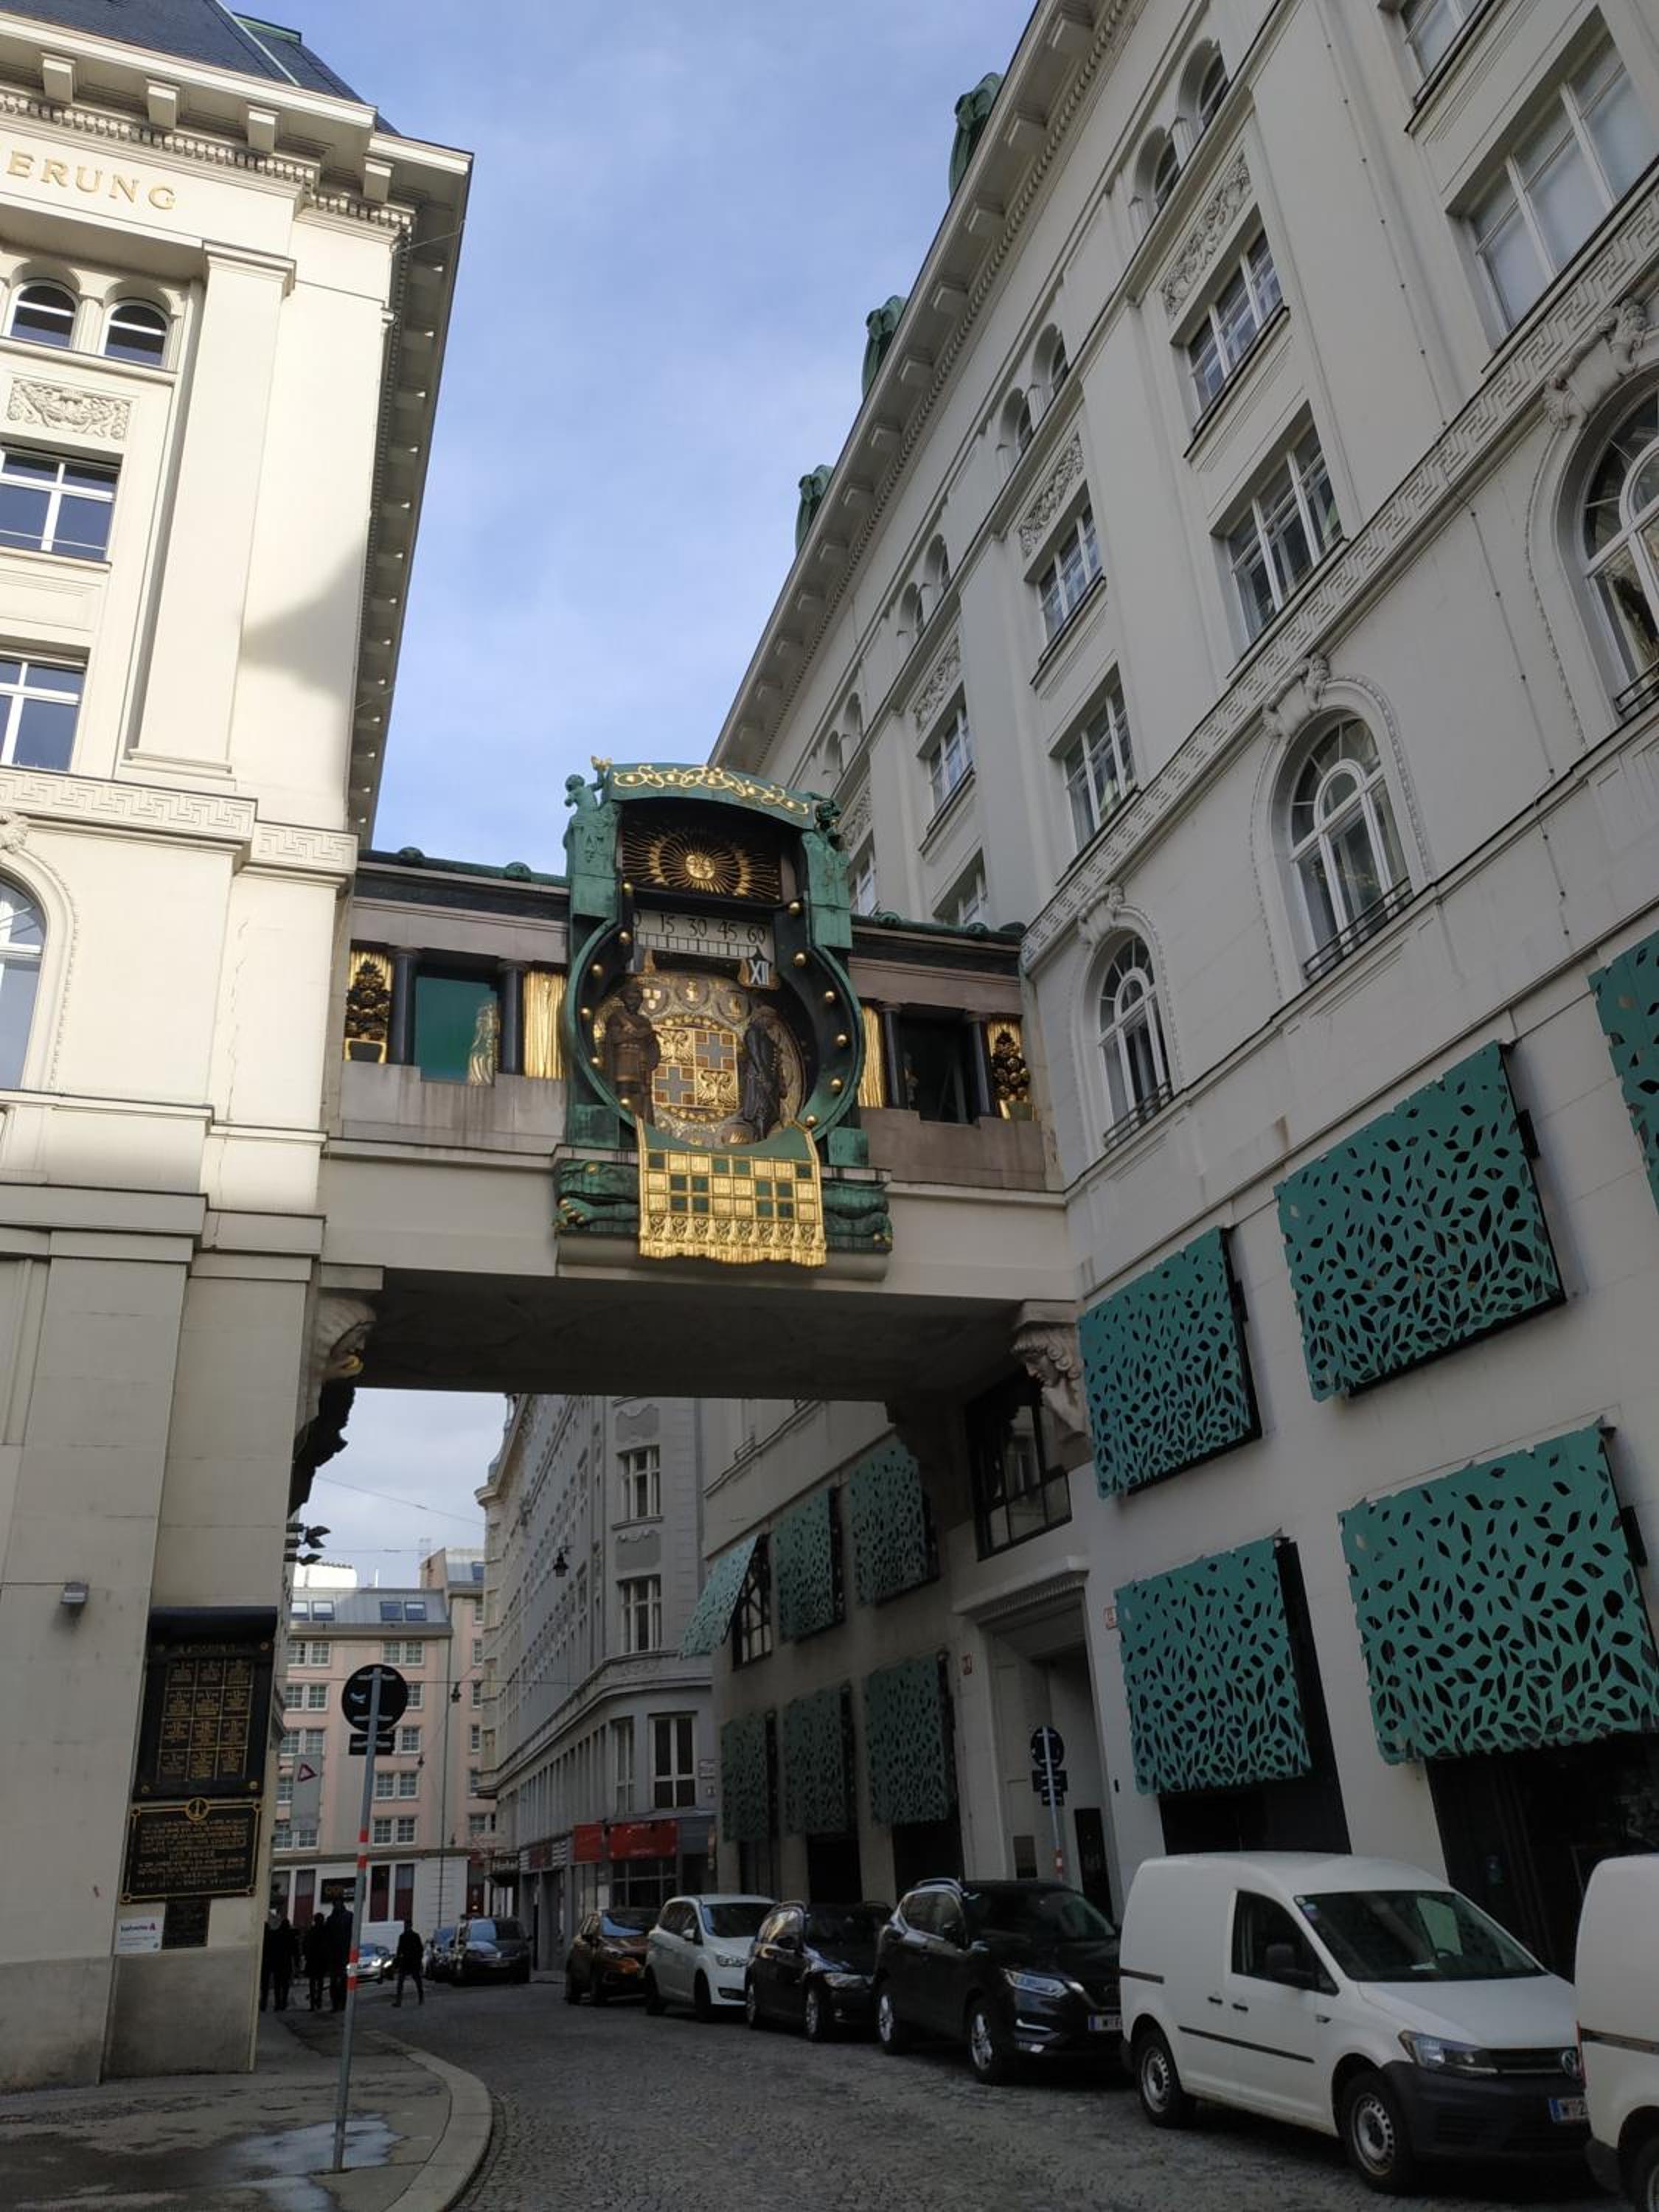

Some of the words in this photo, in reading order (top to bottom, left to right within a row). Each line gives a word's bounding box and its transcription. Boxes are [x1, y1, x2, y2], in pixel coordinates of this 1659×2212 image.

[6, 150, 177, 210] ERUNG
[661, 914, 675, 934] 15
[687, 917, 708, 938] 30
[717, 920, 738, 942] 45
[747, 925, 766, 945] 60
[749, 959, 770, 986] XII
